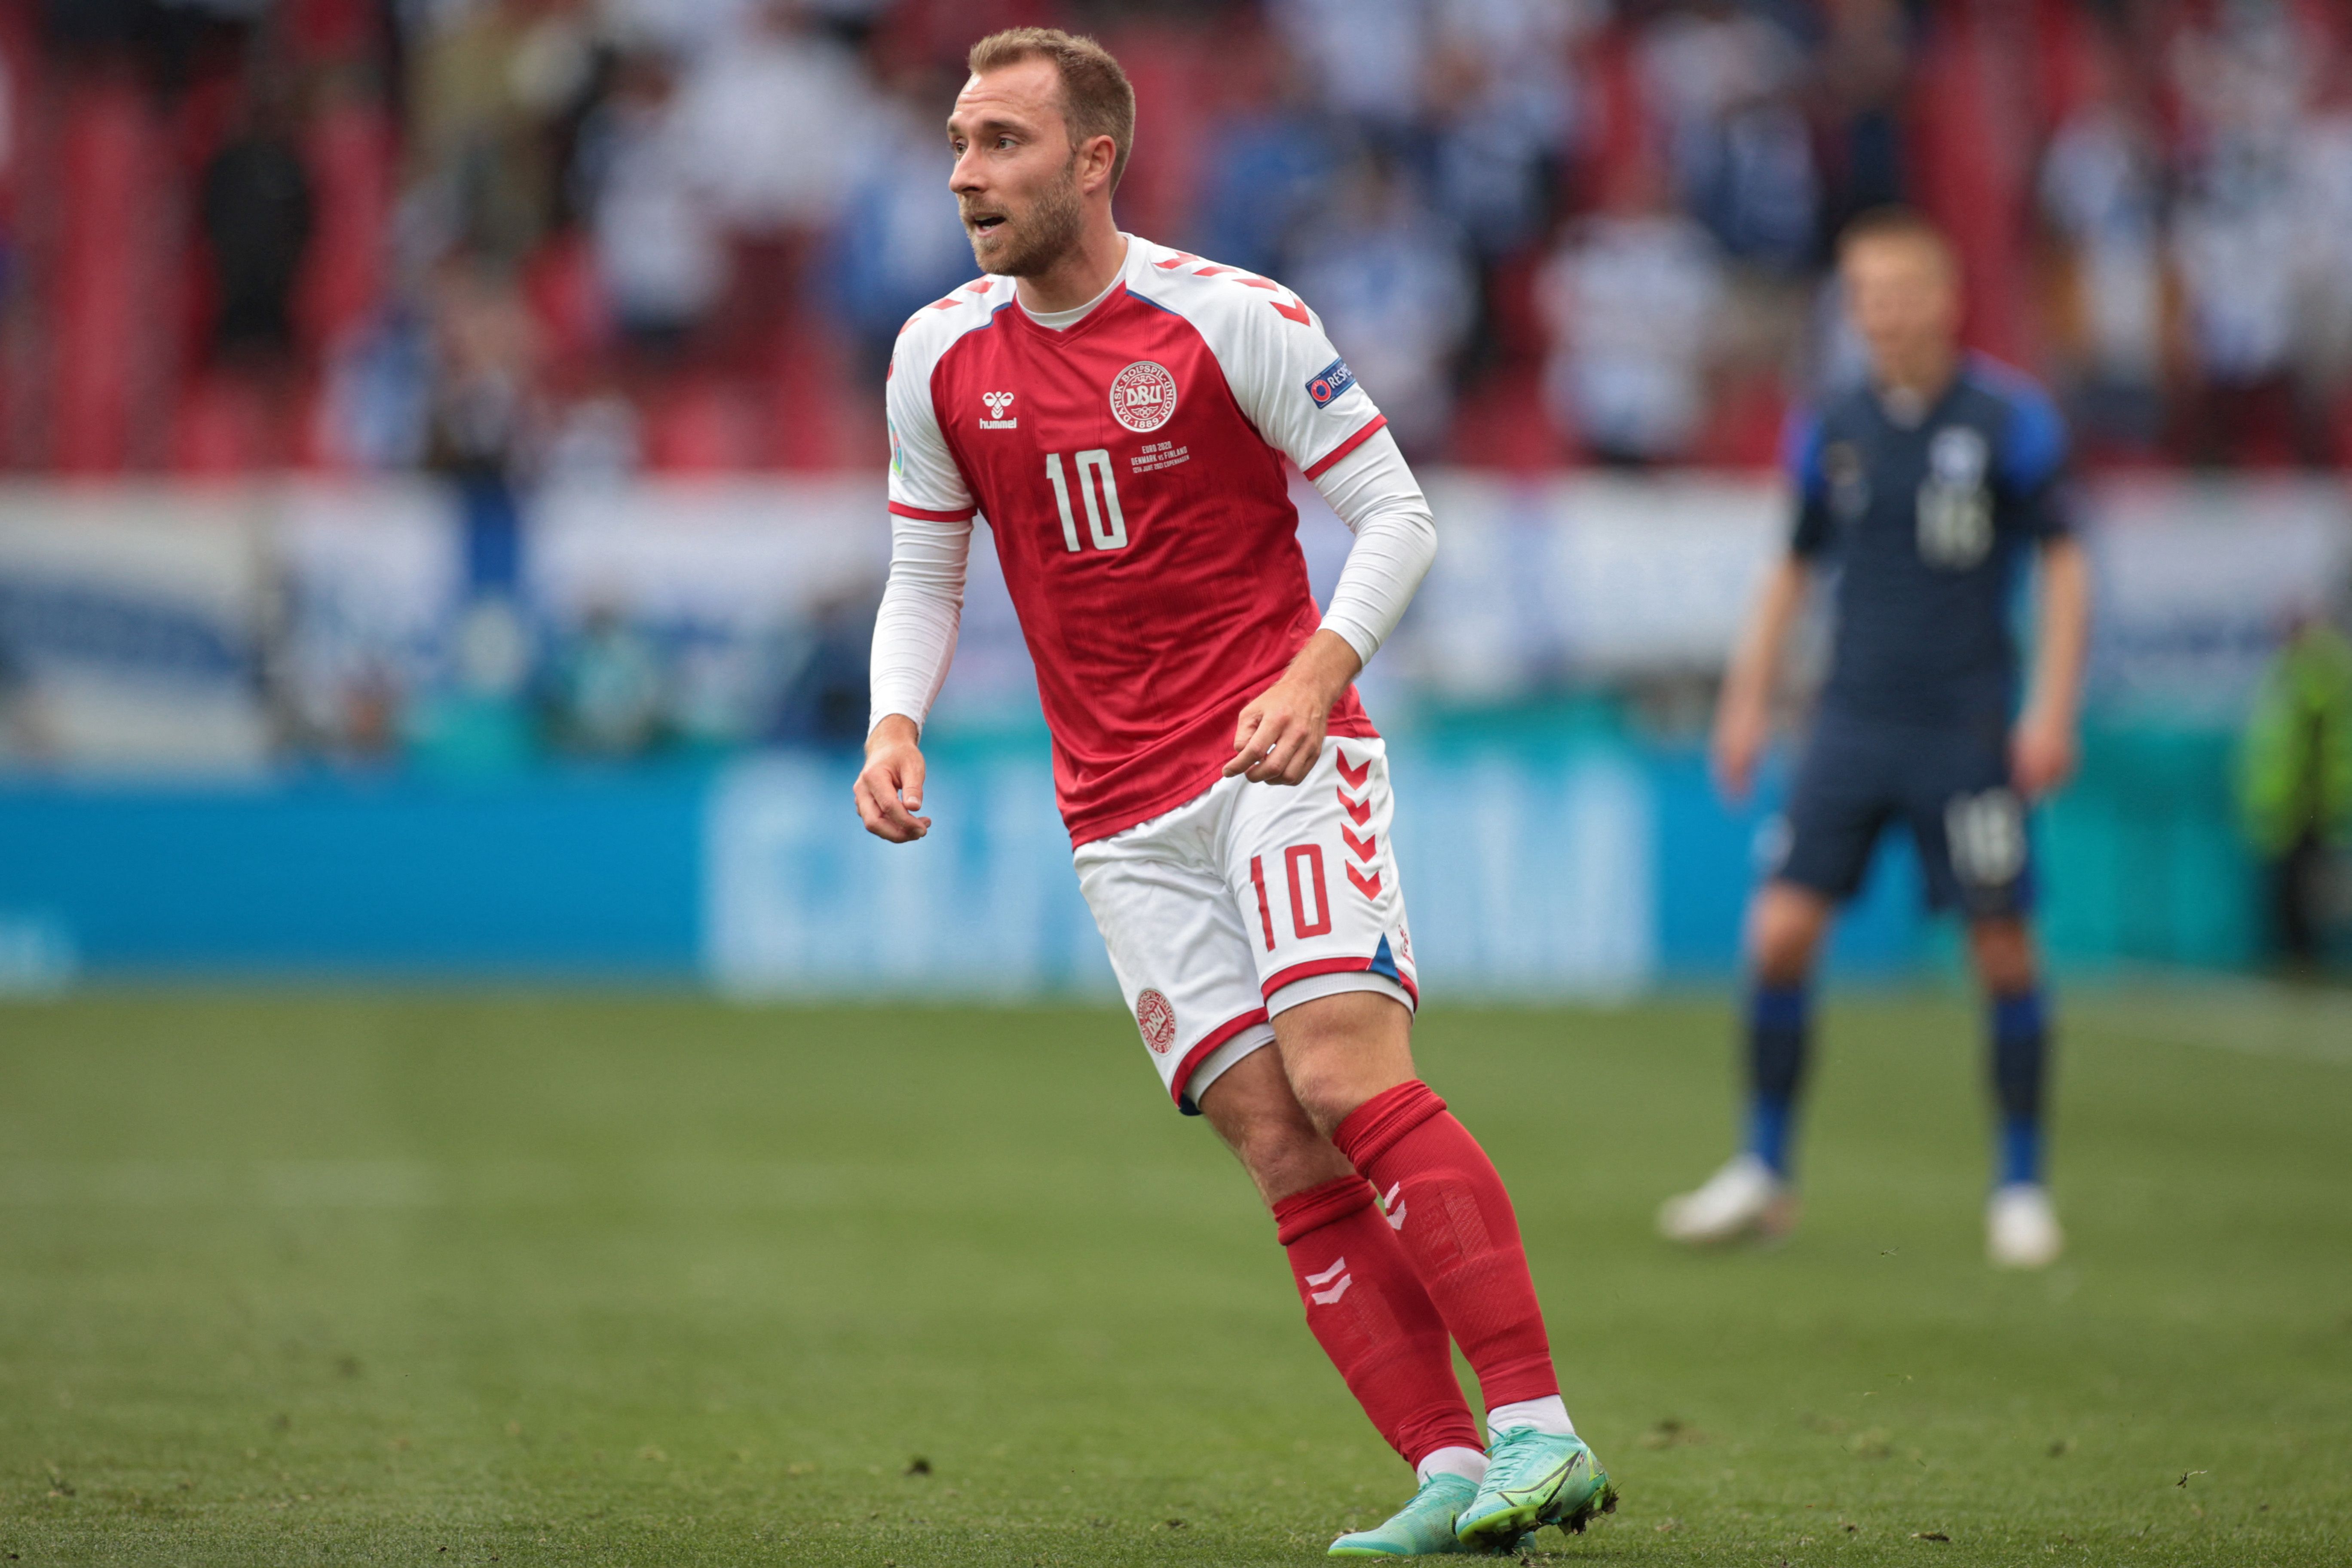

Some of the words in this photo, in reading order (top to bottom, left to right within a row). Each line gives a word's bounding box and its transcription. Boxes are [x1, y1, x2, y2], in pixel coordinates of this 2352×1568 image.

[1114, 385, 1131, 423] DANSK
[1160, 381, 1173, 417] UNION
[1125, 385, 1163, 406] DBU
[979, 417, 1017, 429] hummel
[1133, 417, 1159, 428] 1889
[1131, 454, 1158, 466] DENMARK
[1164, 446, 1188, 459] FINLAND
[1142, 444, 1157, 454] EURO
[1157, 441, 1172, 451] 2020
[1164, 454, 1190, 468] COPENHAGEN
[1046, 449, 1128, 553] 10
[1250, 843, 1332, 952] 10
[1145, 1004, 1167, 1038] DBU
